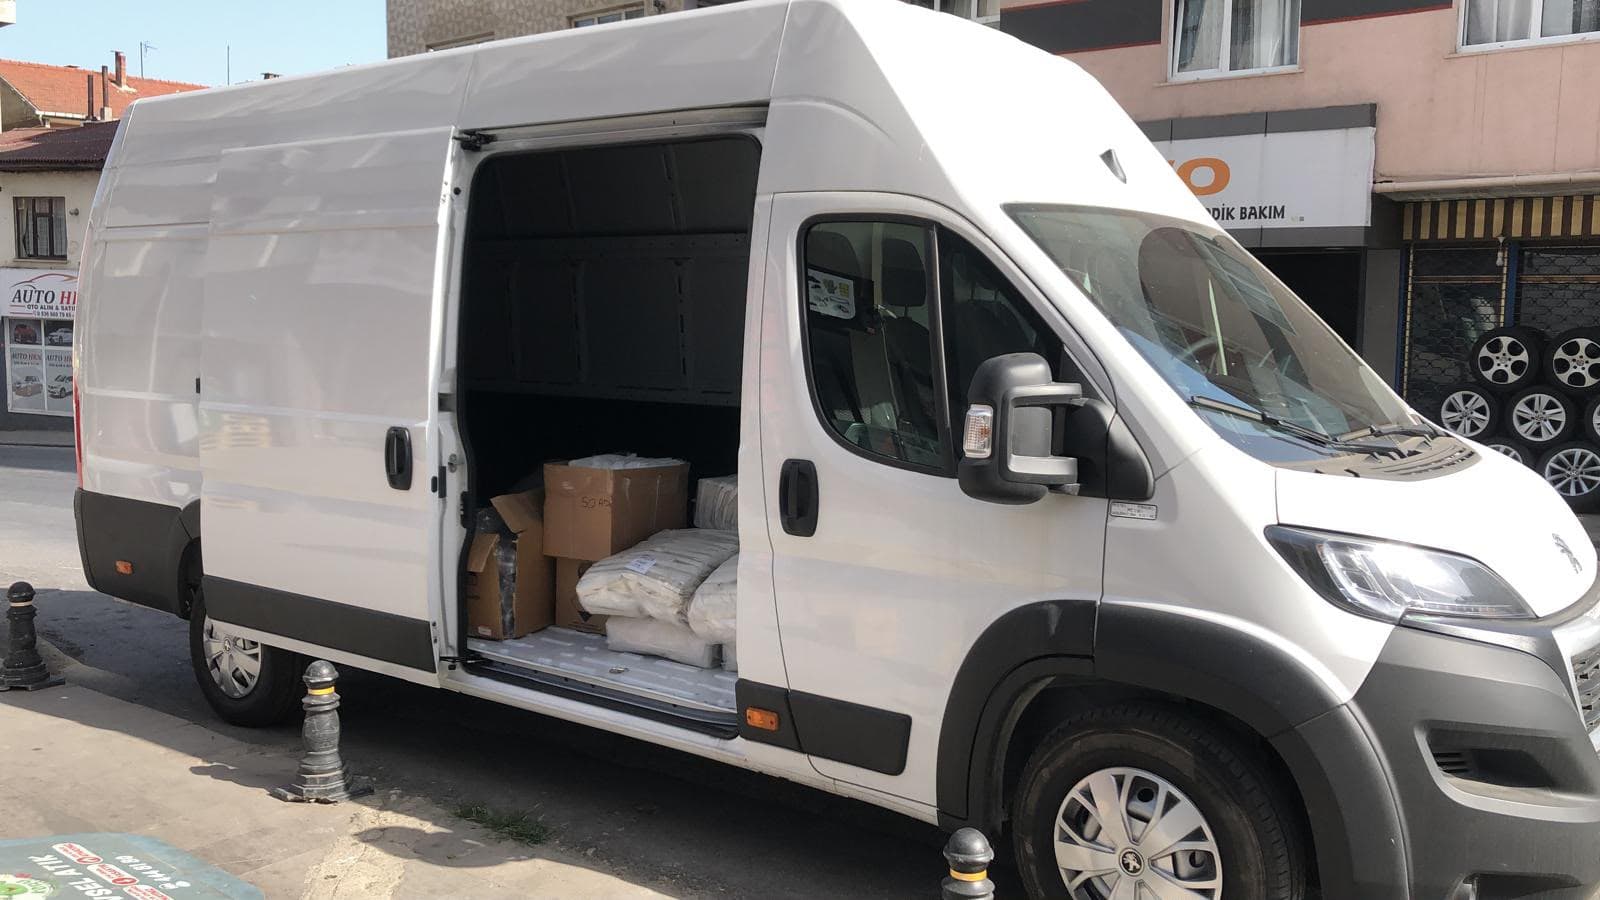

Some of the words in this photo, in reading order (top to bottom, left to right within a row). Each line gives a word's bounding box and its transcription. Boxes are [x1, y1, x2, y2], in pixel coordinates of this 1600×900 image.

[1239, 205, 1286, 220] BAKIM
[12, 289, 55, 304] AUTO
[27, 854, 83, 876] ATIK
